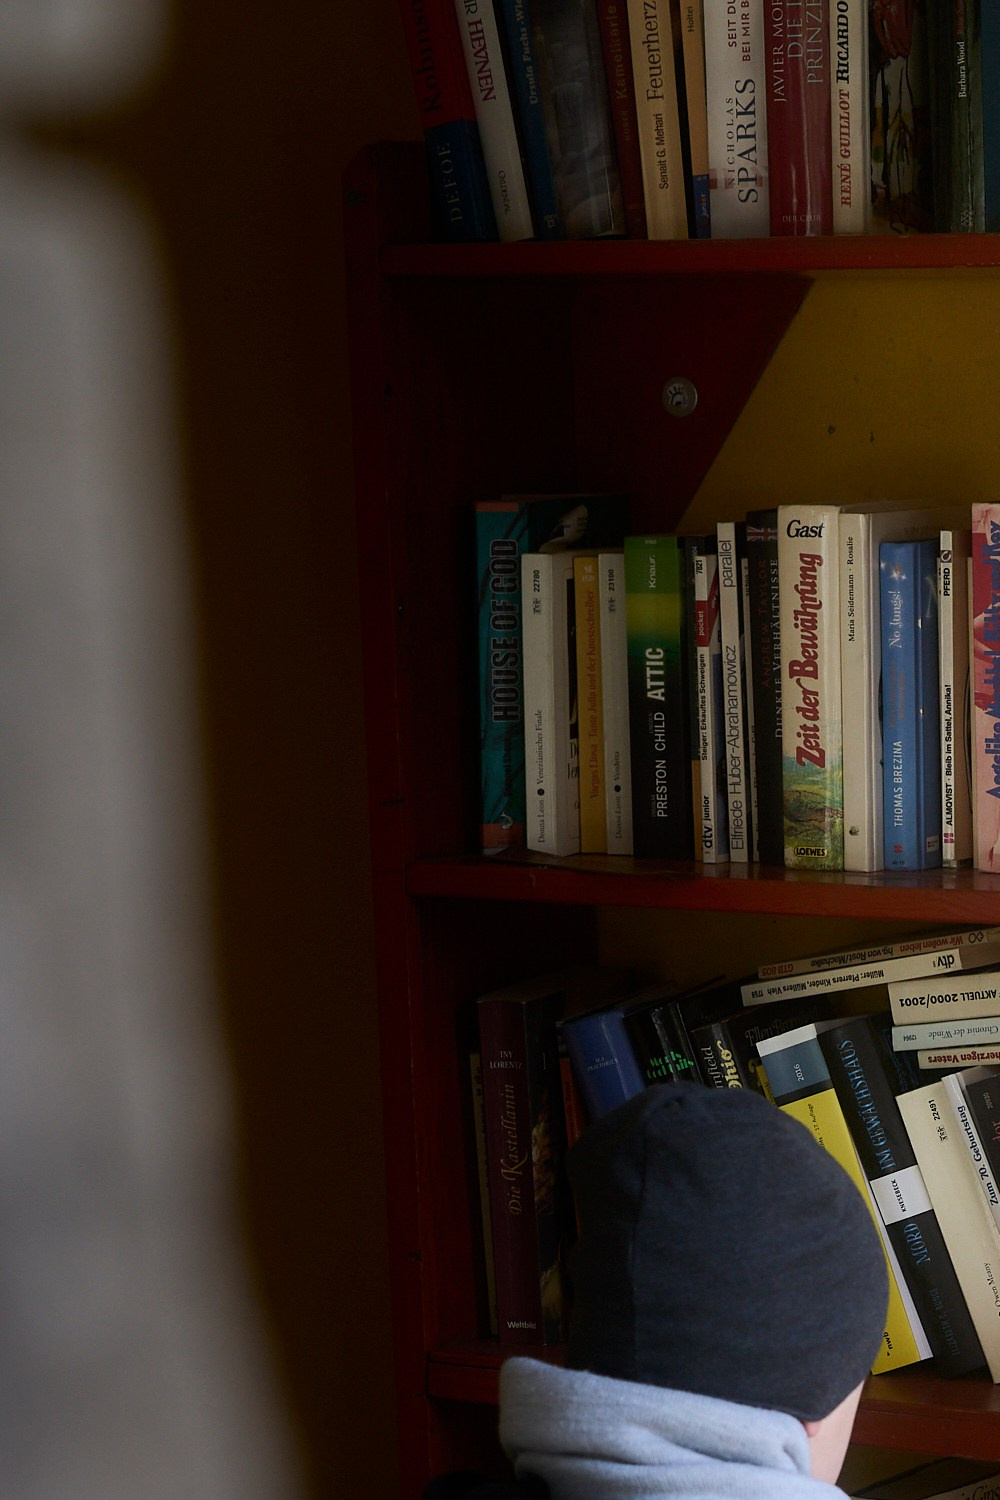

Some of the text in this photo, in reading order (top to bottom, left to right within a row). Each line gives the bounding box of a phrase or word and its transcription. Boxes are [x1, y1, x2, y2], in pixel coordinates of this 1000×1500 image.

[728, 21, 737, 47] SEIT
[742, 12, 751, 61] BEI MIR
[787, 18, 803, 58] DIE
[773, 37, 786, 102] JAVIER
[956, 41, 968, 98] Barbara Wood
[643, 1, 668, 189] Senait Mehari Feuerherz
[836, 1, 852, 207] RENÉ GUILLOT RICARDO
[726, 79, 758, 203] NICHOLAS SPARKS
[787, 519, 826, 539] Gast
[943, 567, 951, 597] PFERD
[490, 539, 520, 723] HOUSE OF GOD
[646, 647, 664, 702] ATTIC
[789, 553, 826, 769] Zeit Bewährung
[700, 692, 708, 729] Erkauftes
[721, 540, 744, 851] Elfriede parallel
[656, 711, 666, 753] CHILD
[656, 759, 669, 818] PRESTON
[893, 740, 903, 827] THOMAS BREZINA
[703, 826, 712, 848] dtv
[796, 847, 825, 856] LOEWES
[899, 993, 958, 1007] 2000/2001
[964, 990, 997, 1001] AKTUELL
[490, 1060, 523, 1070] LORENTZ
[928, 1053, 959, 1063] Vaters
[929, 1099, 941, 1120] 22491
[873, 1152, 896, 1171] IM
[508, 1182, 523, 1216] Die
[891, 1179, 906, 1212] KNESEBECK
[904, 1222, 931, 1265] MORD
[507, 1321, 537, 1329] Weltbild
